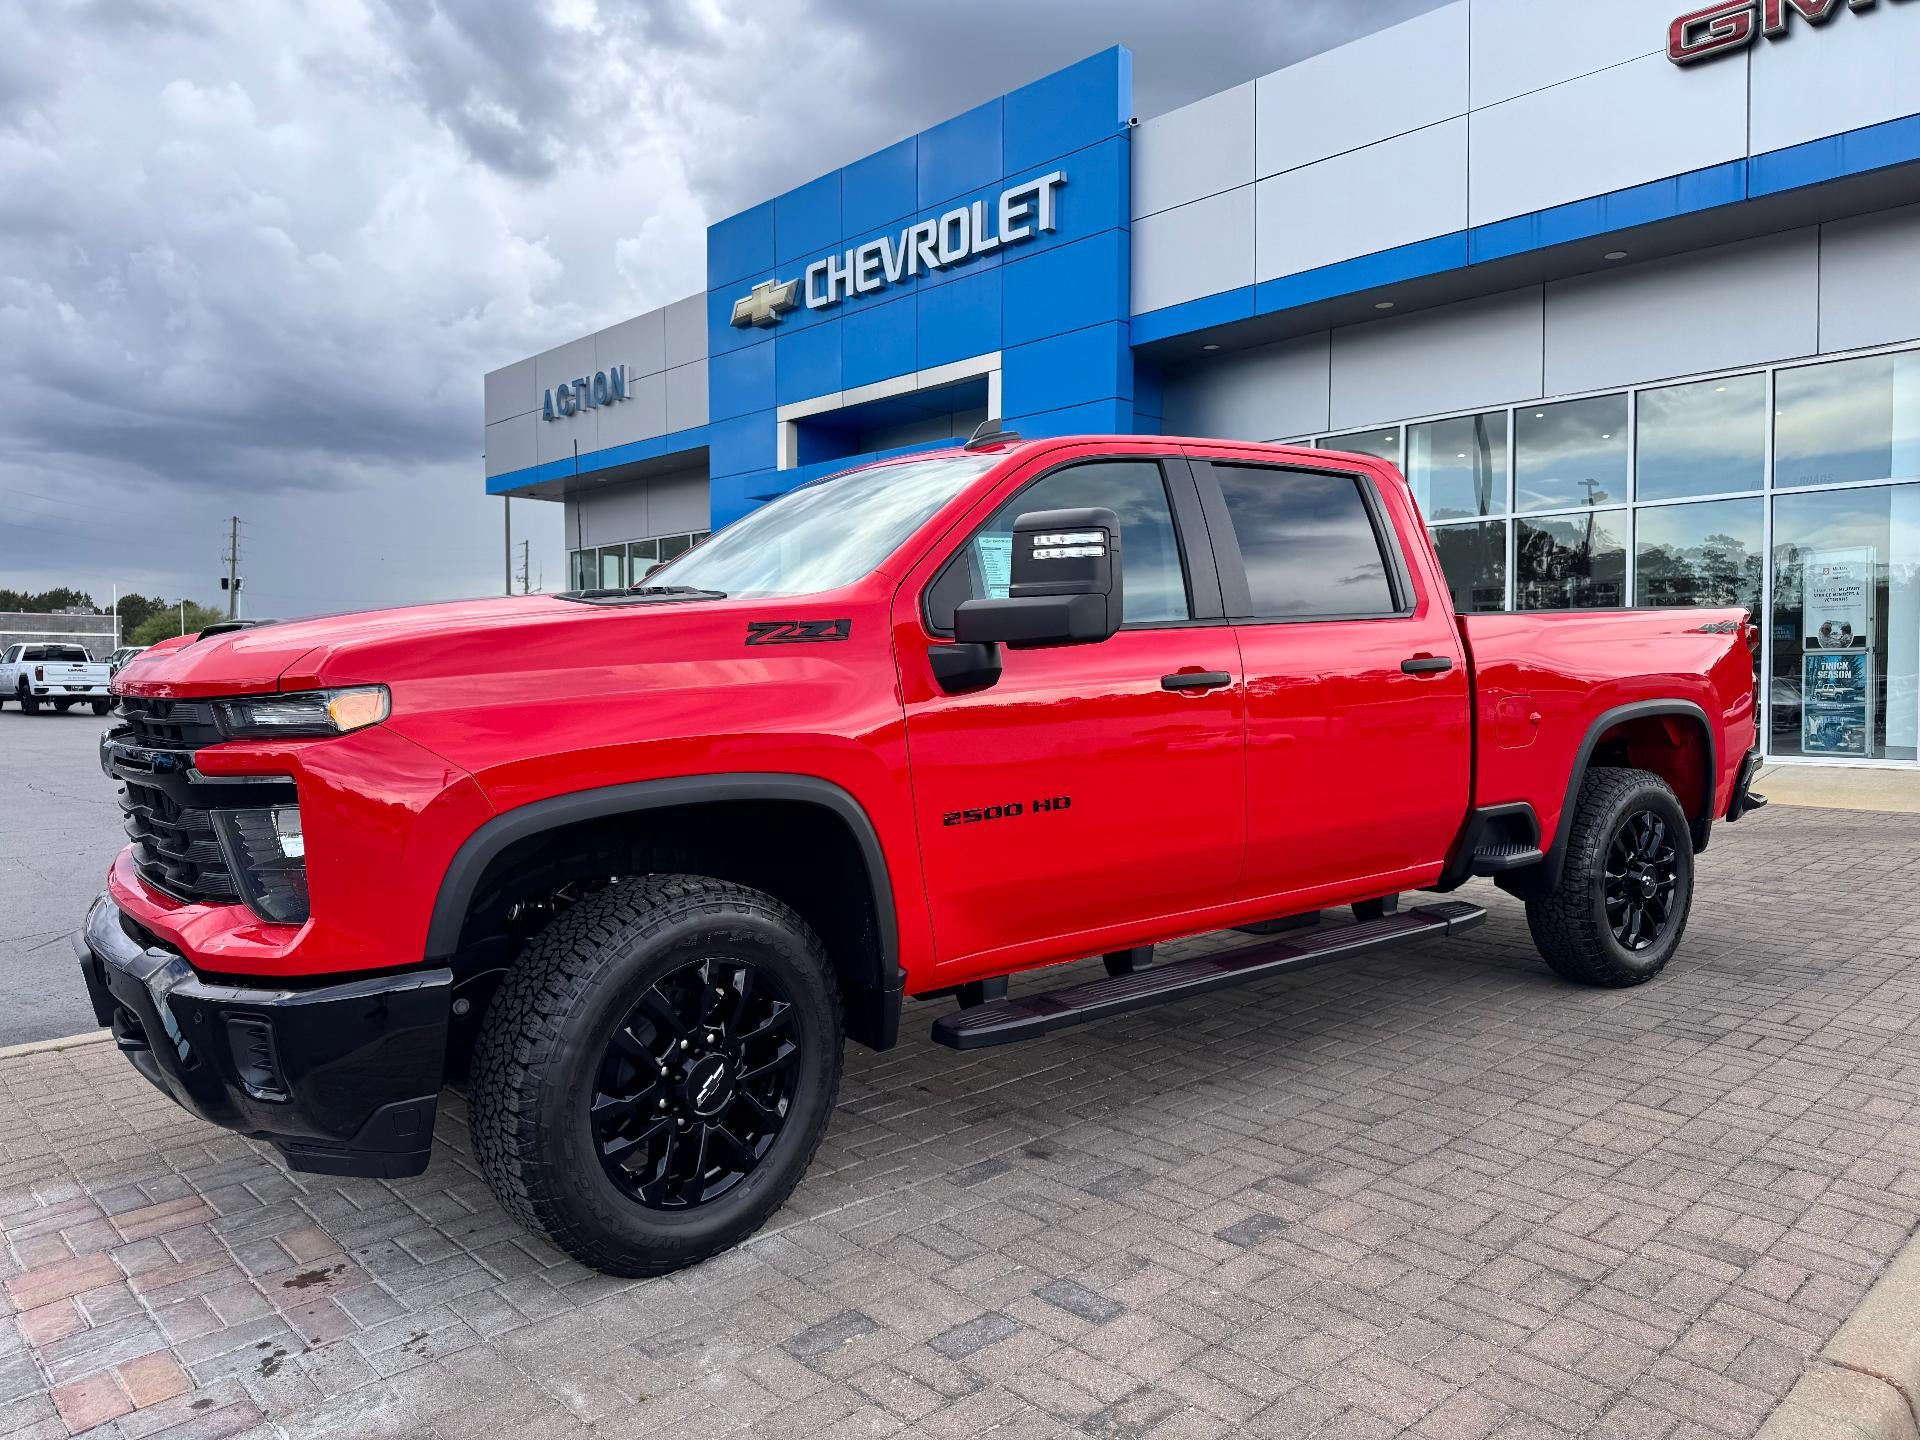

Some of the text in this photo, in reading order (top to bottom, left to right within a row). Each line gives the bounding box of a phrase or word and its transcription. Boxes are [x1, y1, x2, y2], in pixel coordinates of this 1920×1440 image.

[1666, 0, 1877, 65] GM
[805, 170, 1068, 310] CHEVROLET
[543, 364, 630, 421] ACTION
[1817, 670, 1852, 679] SEASON
[1820, 661, 1849, 671] TRUCK
[943, 796, 1071, 826] 2500 HD
